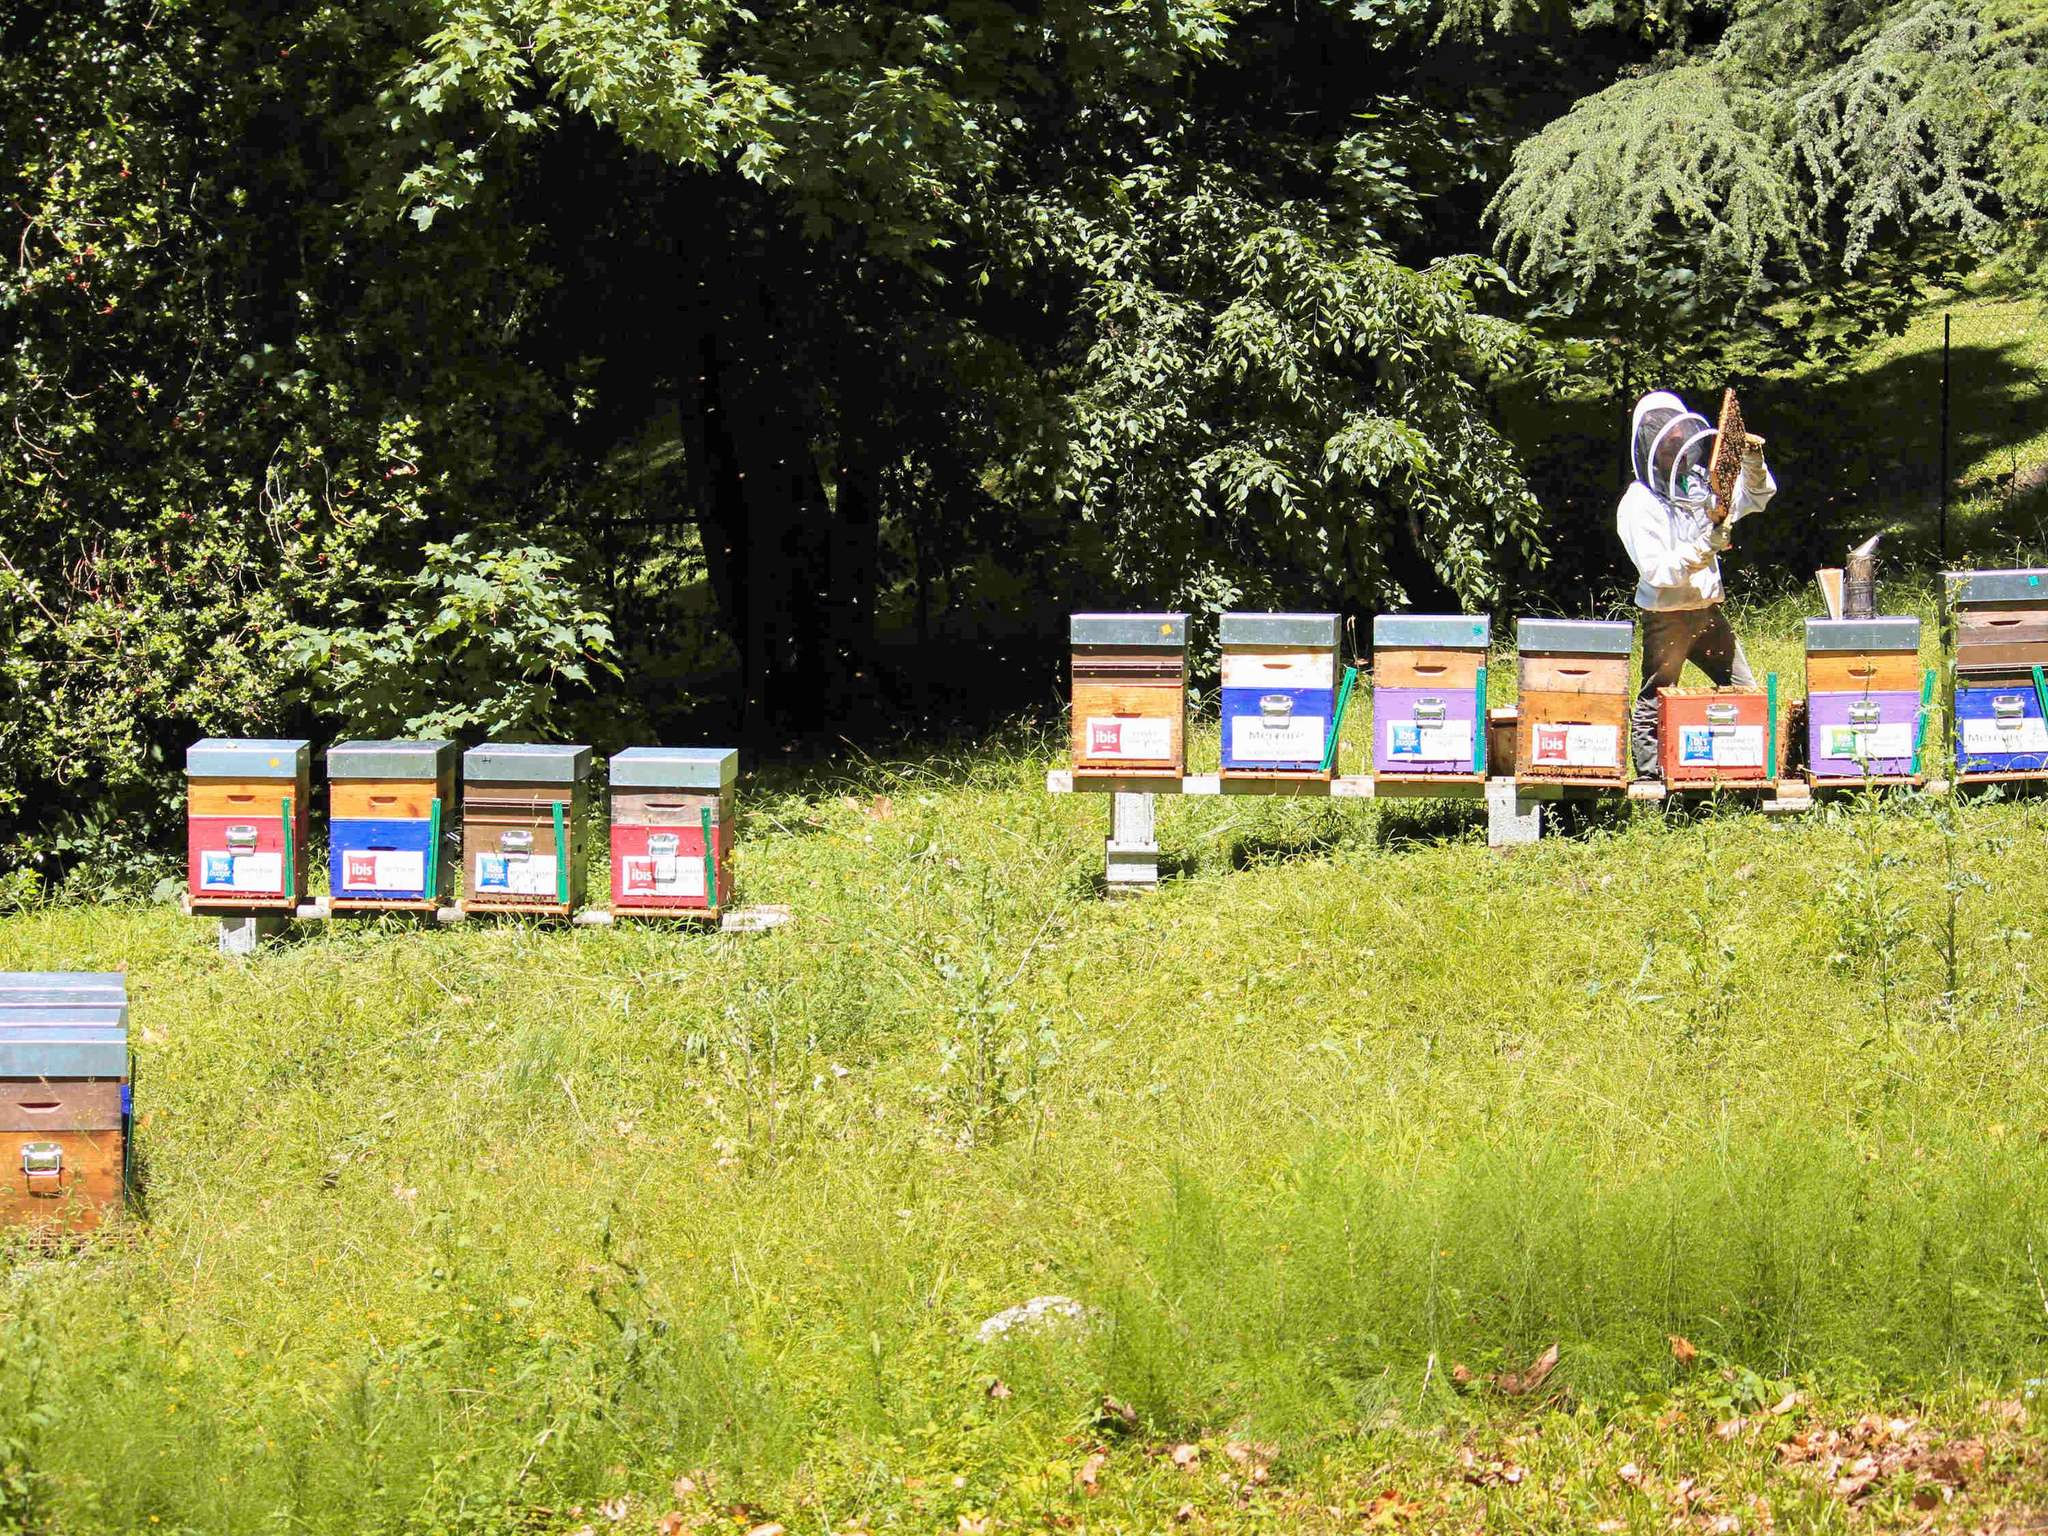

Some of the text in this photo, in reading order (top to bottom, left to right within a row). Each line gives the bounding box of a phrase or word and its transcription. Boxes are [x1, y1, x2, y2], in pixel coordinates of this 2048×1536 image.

[1095, 730, 1118, 744] ibis
[1541, 736, 1563, 750] ibis
[211, 861, 229, 871] ibis
[351, 862, 373, 876] ibis
[631, 868, 653, 880] ibis
